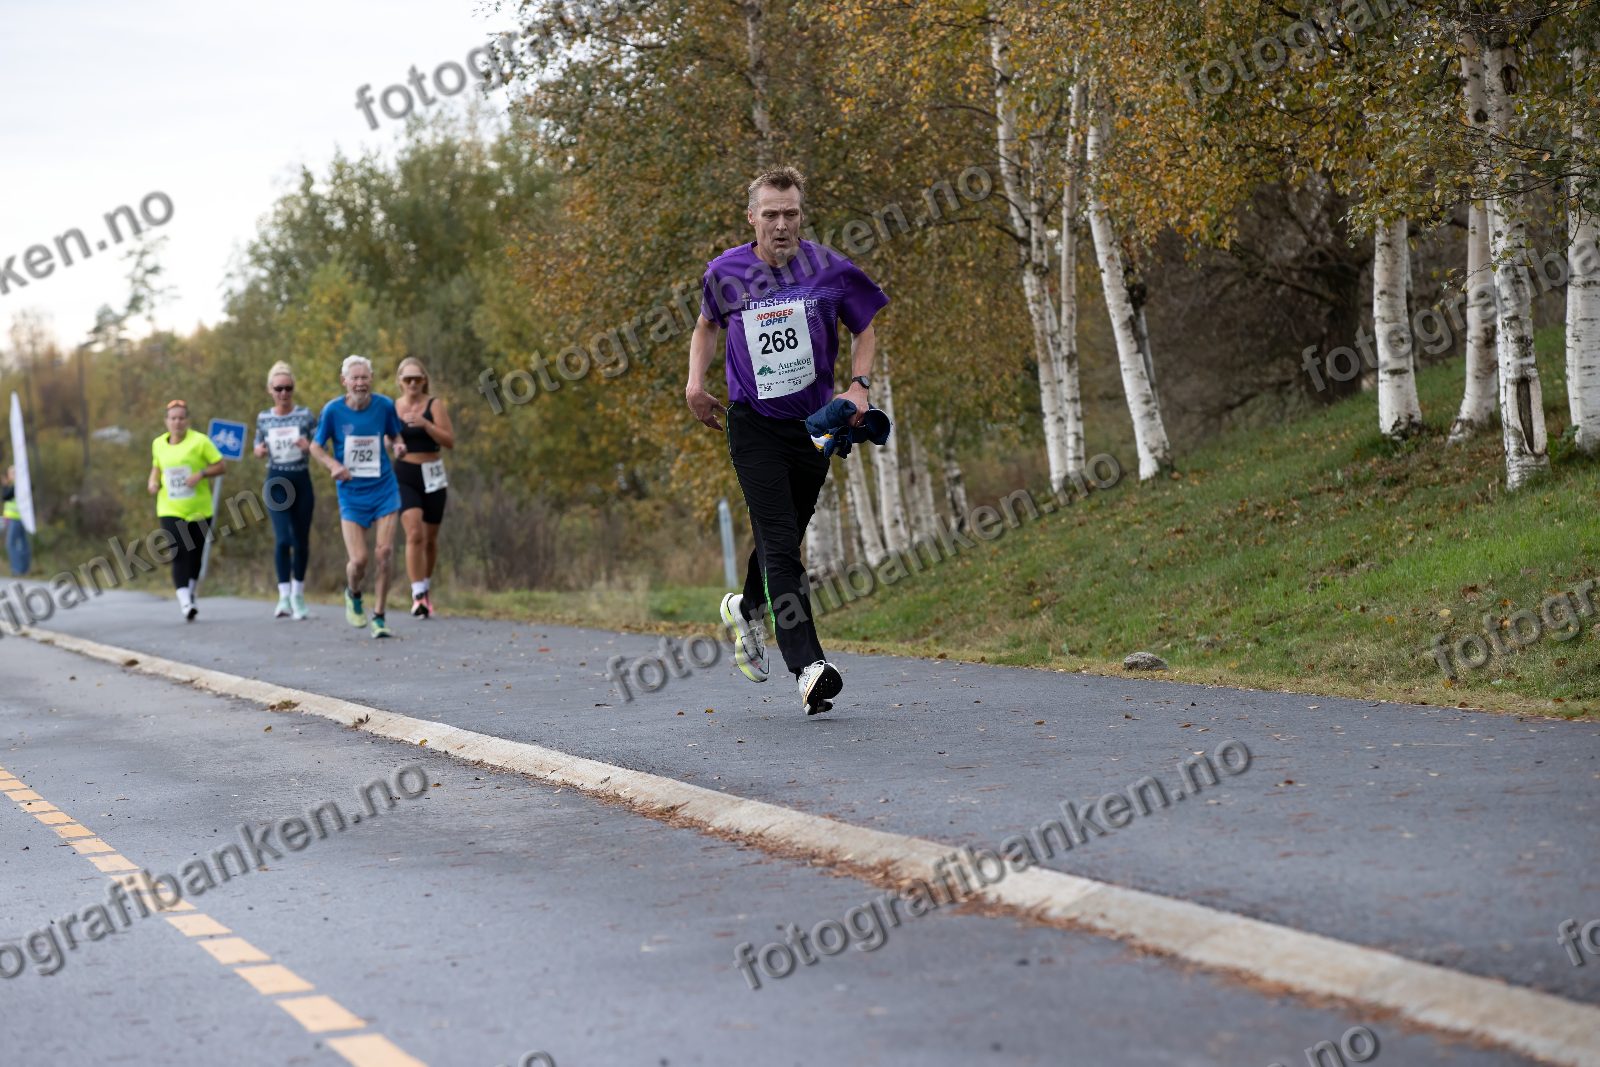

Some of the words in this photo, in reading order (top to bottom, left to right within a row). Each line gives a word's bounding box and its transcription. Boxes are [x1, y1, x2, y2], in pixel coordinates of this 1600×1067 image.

[755, 308, 794, 321] NORGES
[760, 316, 789, 328] LØPET
[758, 327, 799, 355] 268
[777, 357, 812, 372] Aurskog
[350, 449, 374, 463] 752
